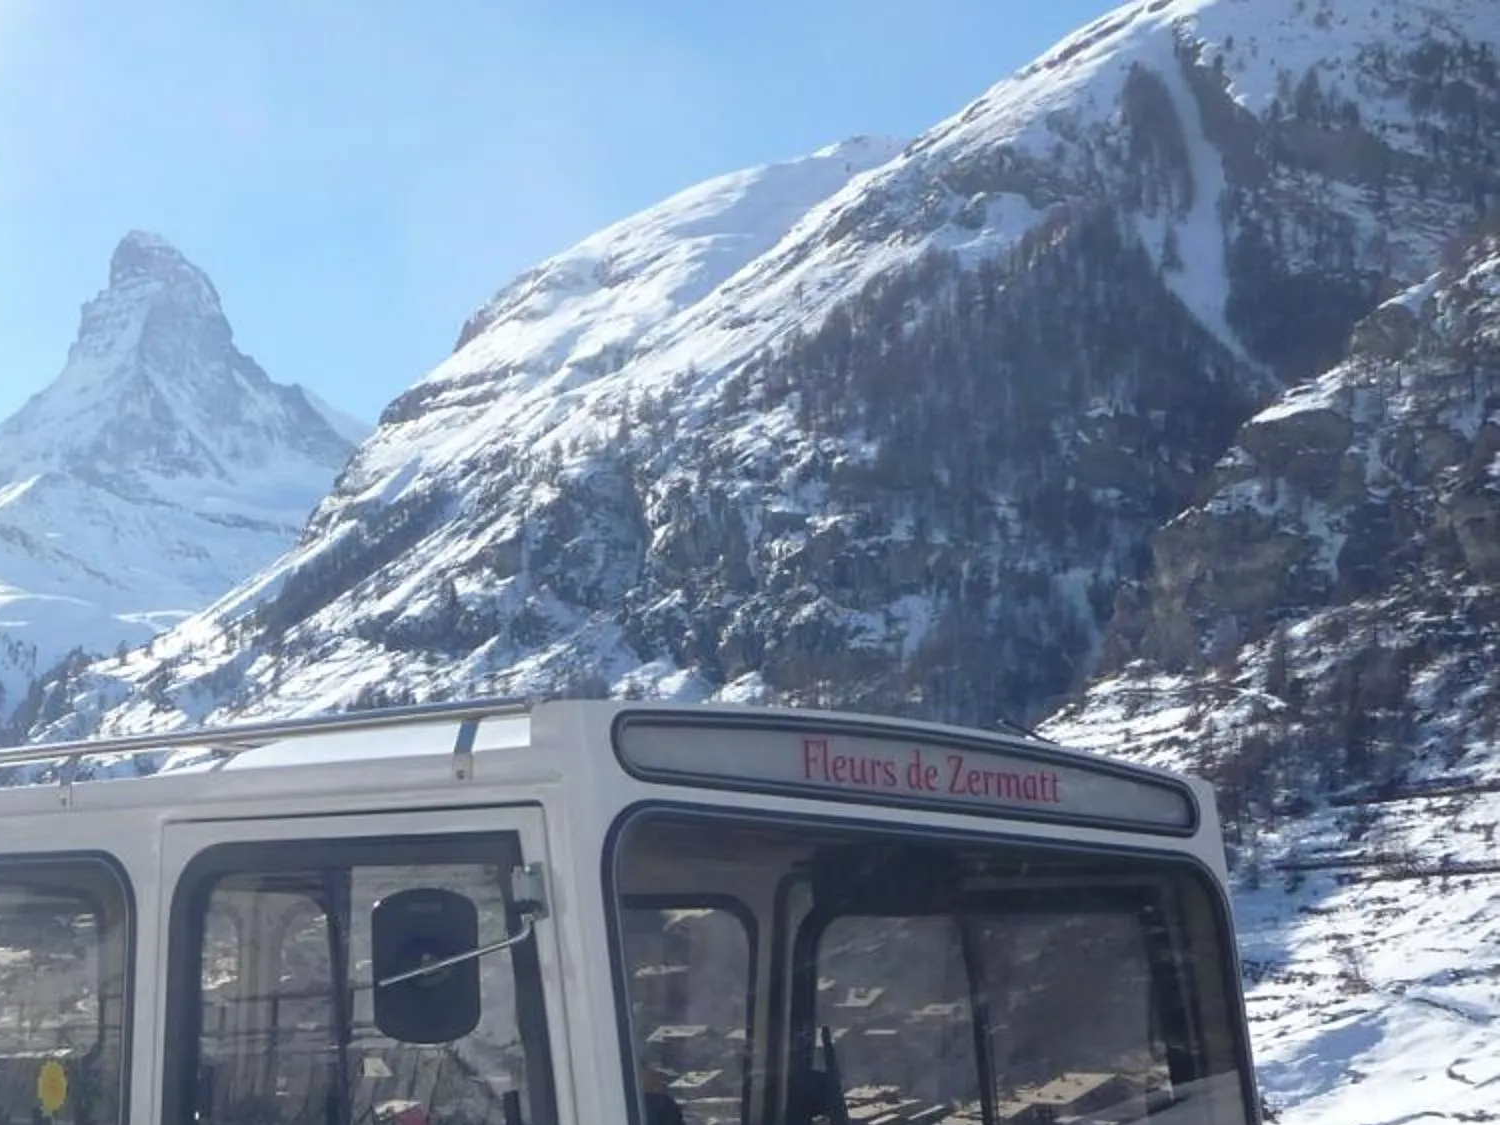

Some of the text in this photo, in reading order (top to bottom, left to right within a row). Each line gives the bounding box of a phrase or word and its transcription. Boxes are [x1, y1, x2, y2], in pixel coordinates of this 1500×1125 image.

[803, 739, 1061, 803] Fleurs de Zermatt
